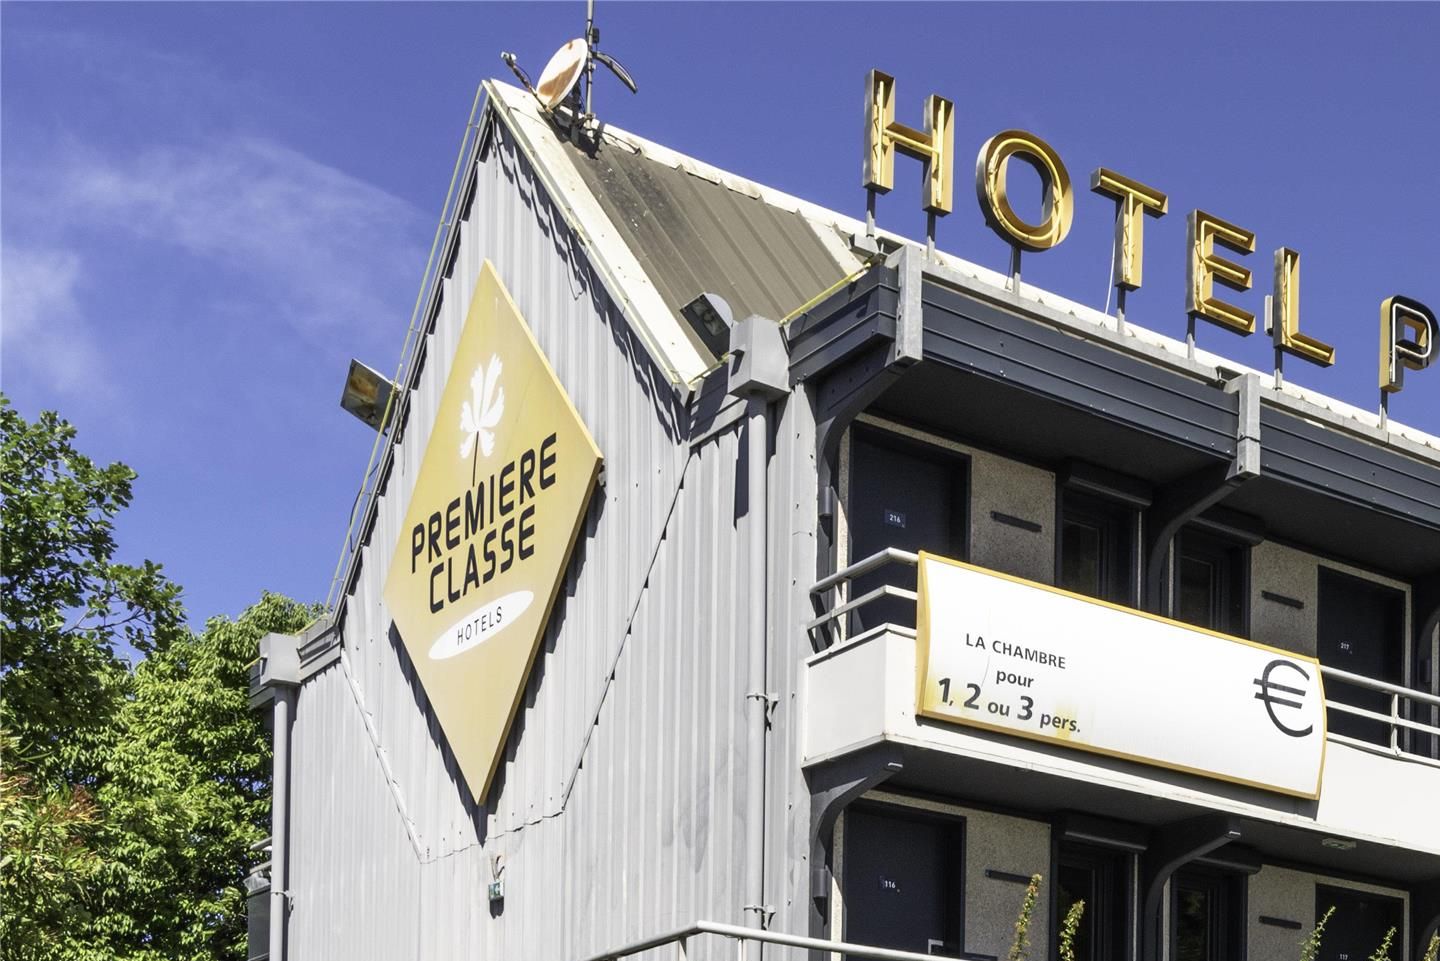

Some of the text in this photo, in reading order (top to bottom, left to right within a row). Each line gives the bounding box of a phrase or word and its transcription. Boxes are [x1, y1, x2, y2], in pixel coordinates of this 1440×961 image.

[863, 68, 1336, 367] HOTEL
[411, 432, 558, 575] PREMIERE
[430, 507, 536, 615] CLASSE
[456, 605, 504, 646] HOTELS
[965, 632, 1067, 670] LA CHAMBRE
[937, 677, 1082, 734] 1, 2 ou 3 pers.
[995, 668, 1035, 689] pour
